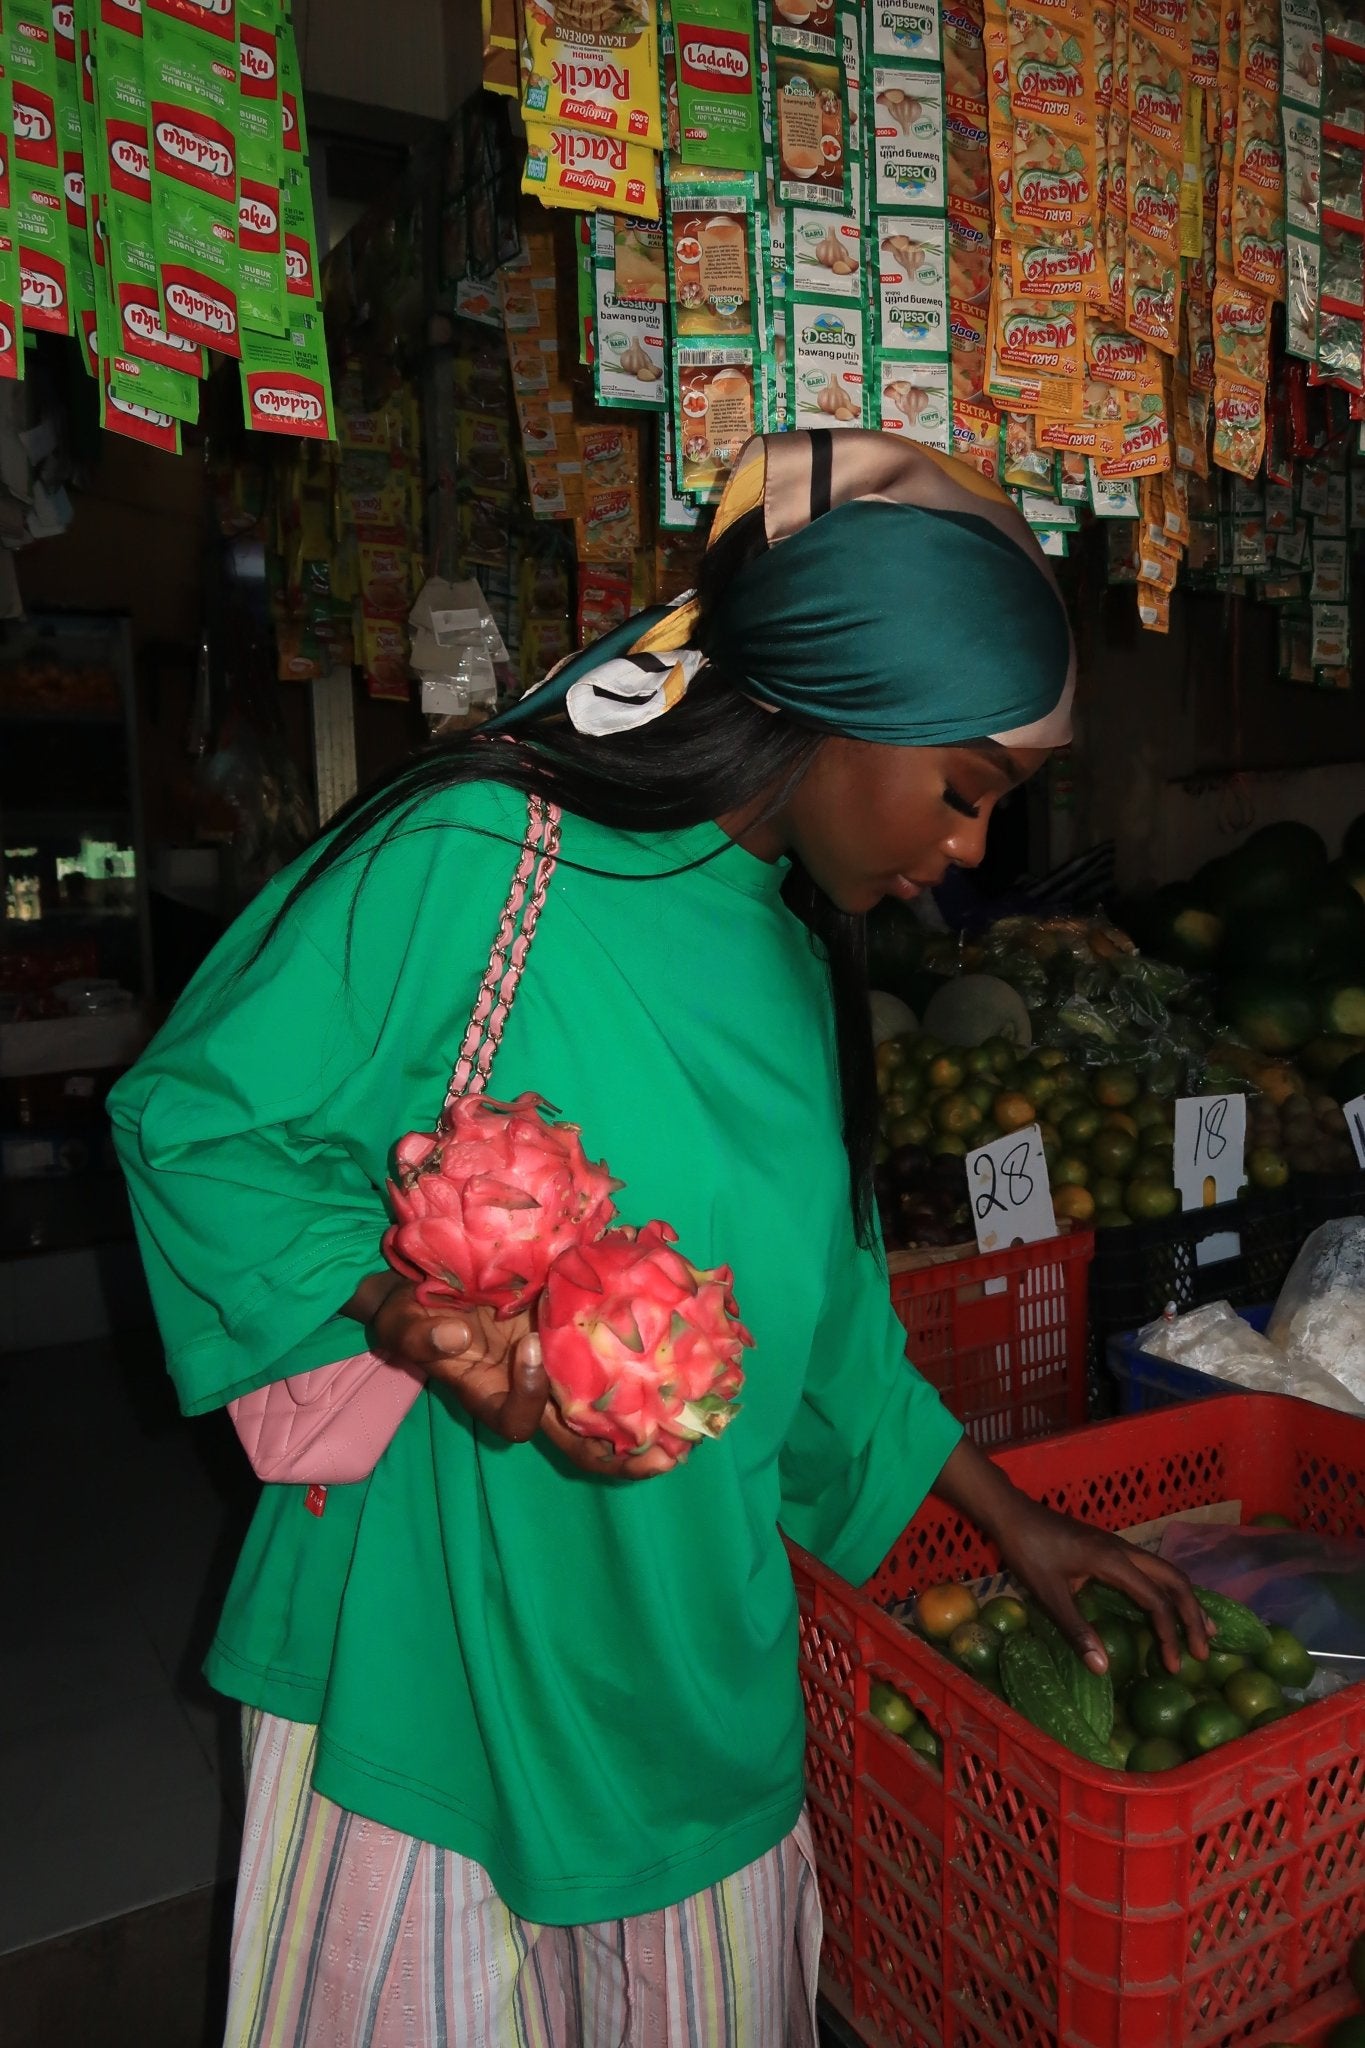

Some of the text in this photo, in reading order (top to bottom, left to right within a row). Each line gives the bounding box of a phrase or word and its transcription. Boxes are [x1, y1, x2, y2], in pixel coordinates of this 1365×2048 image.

[902, 2, 935, 15] bawang
[882, 11, 933, 35] Desaku
[942, 9, 981, 36] Sedaa
[1153, 19, 1176, 38] BARU
[555, 27, 627, 47] IKAN GORENG
[11, 55, 36, 67] MERI
[240, 50, 268, 74] aku
[572, 52, 604, 61] Bumbu
[687, 46, 744, 73] Ladaku
[551, 62, 630, 100] Racik
[1022, 72, 1084, 97] Masako
[784, 85, 815, 98] Desaku
[566, 104, 612, 123] Indofood
[694, 105, 746, 118] MERICA BUBUK
[964, 100, 986, 115] EXT
[1042, 101, 1070, 115] BARU
[1136, 95, 1183, 125] Masako
[946, 119, 987, 141] edaap
[1151, 124, 1172, 141] BARU
[119, 145, 149, 172] aku
[163, 128, 229, 173] Ladaku
[550, 132, 627, 170] Racik
[880, 149, 940, 162] bawang putih
[565, 173, 610, 192] Indofood
[884, 161, 937, 184] Desaku
[1258, 172, 1280, 189] BARU
[1023, 179, 1089, 204] Masako
[239, 205, 271, 230] aku
[955, 199, 990, 218] 2 EXTR
[1044, 210, 1071, 221] BARU
[18, 222, 48, 235] MERIC
[949, 221, 984, 241] daap
[1150, 226, 1170, 241] BARU
[1029, 248, 1095, 279] Masako
[1242, 243, 1286, 269] Masako
[1253, 266, 1276, 283] BARU
[21, 276, 56, 303] Lad
[1051, 282, 1081, 295] BARU
[709, 293, 744, 305] Desaku
[885, 295, 943, 308] bawang putih
[953, 300, 986, 318] 2 EXTR
[172, 290, 232, 330] Ladaku
[600, 312, 660, 325] bawang putih
[889, 307, 941, 328] Desaku
[1216, 304, 1265, 327] Masako
[802, 327, 856, 348] Desaku
[950, 322, 980, 342] daap
[1009, 324, 1076, 350] Masako
[799, 348, 860, 361] bawang putih
[1030, 354, 1059, 365] BARU
[1096, 340, 1147, 366] Masako
[806, 378, 825, 387] BARU
[1113, 369, 1137, 383] BARU
[260, 391, 318, 416] Ladaku
[960, 402, 991, 420] EXTRA
[993, 412, 998, 422] 1
[1216, 397, 1260, 422] Masako
[953, 427, 976, 441] aap
[1068, 434, 1096, 446] BARU
[1121, 421, 1168, 455] Masa
[1128, 455, 1157, 471] BARU
[1194, 1098, 1229, 1166] 18
[973, 1142, 1034, 1219] 28
